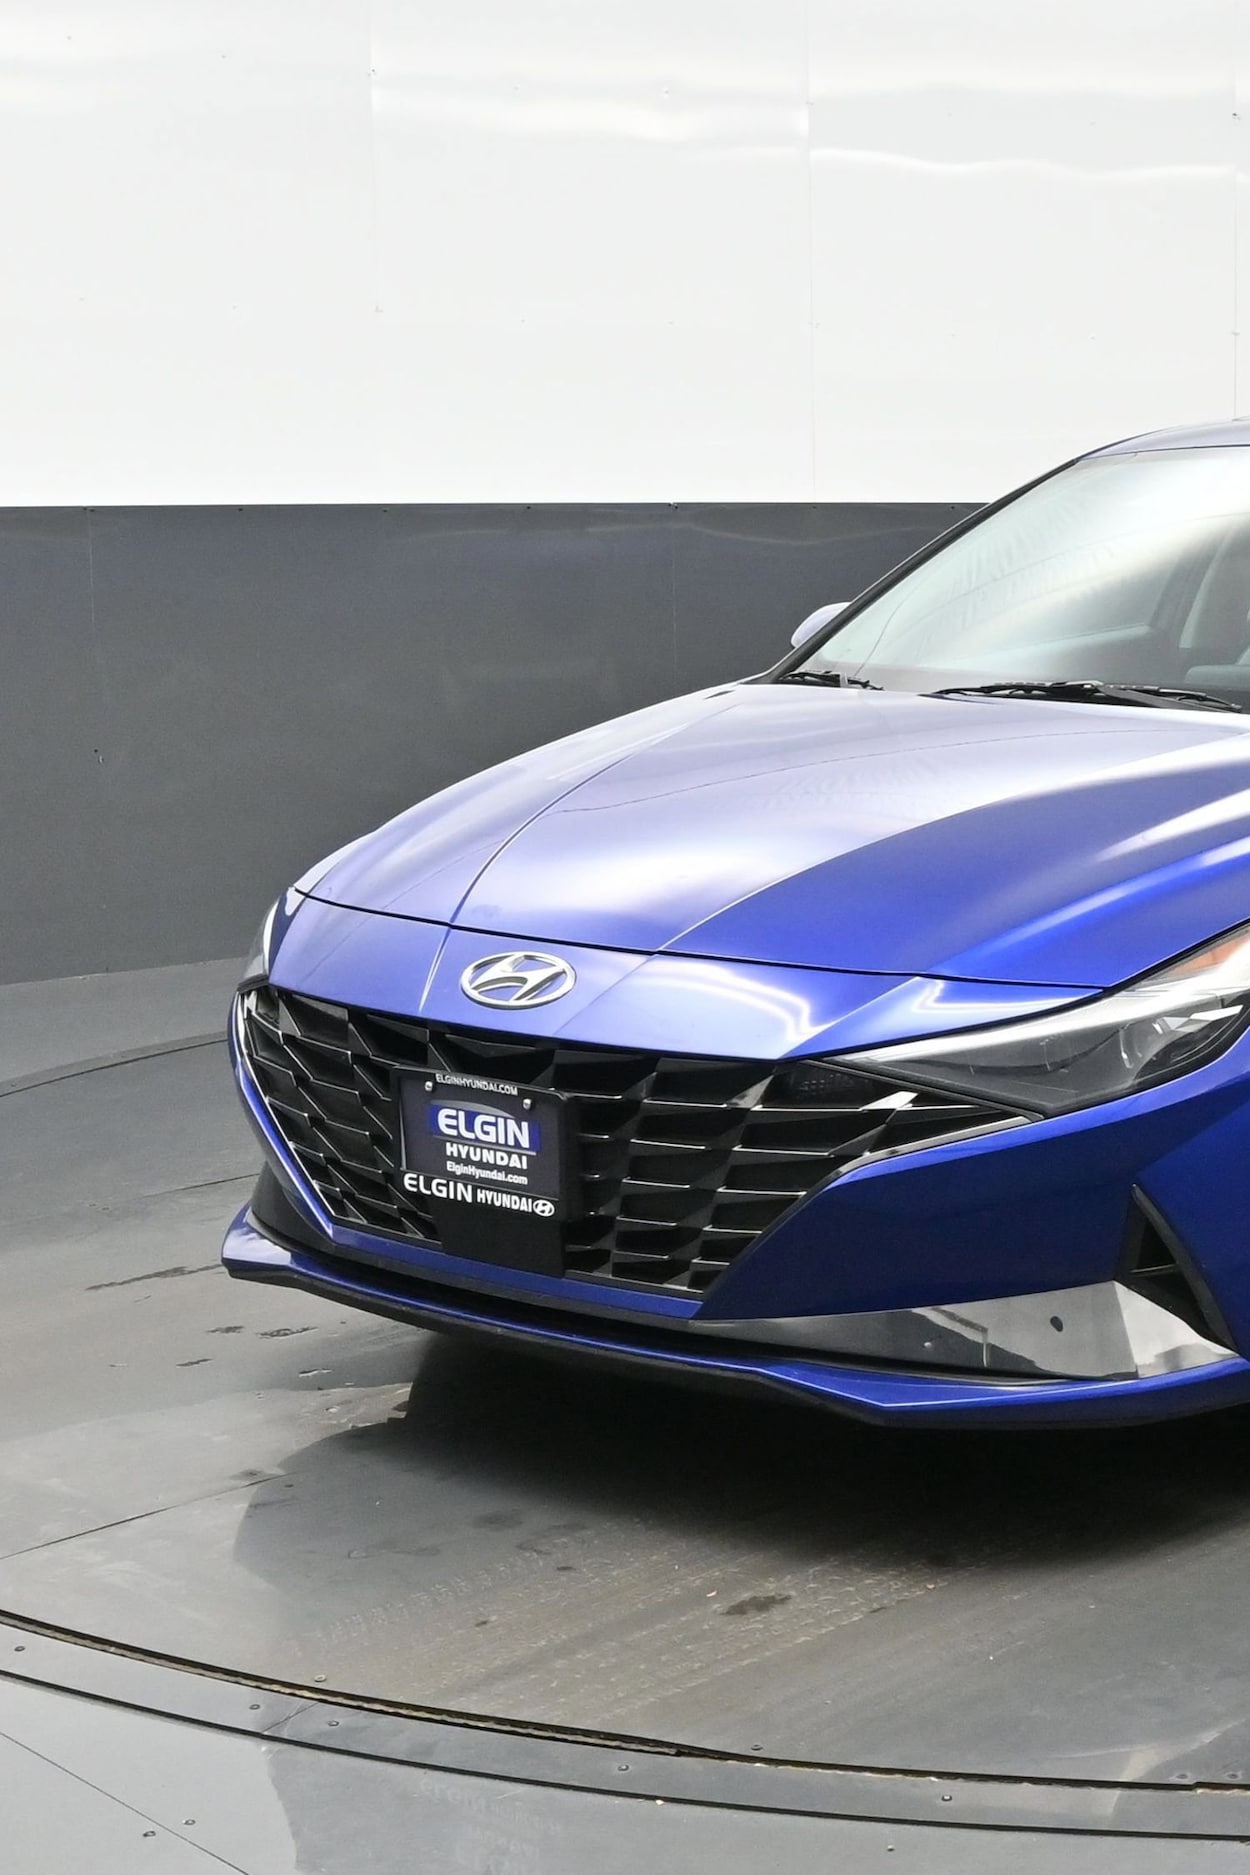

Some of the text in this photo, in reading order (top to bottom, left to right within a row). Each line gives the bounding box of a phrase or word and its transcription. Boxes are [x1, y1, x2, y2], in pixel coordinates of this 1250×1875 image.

[435, 1073, 518, 1096] ELGINHYUNDAI.COM
[437, 1108, 530, 1148] ELGIN
[446, 1142, 528, 1169] HYUNDAI
[446, 1160, 528, 1185] ElginHyundai.com
[403, 1173, 532, 1213] ELGIN HYUNDAI
